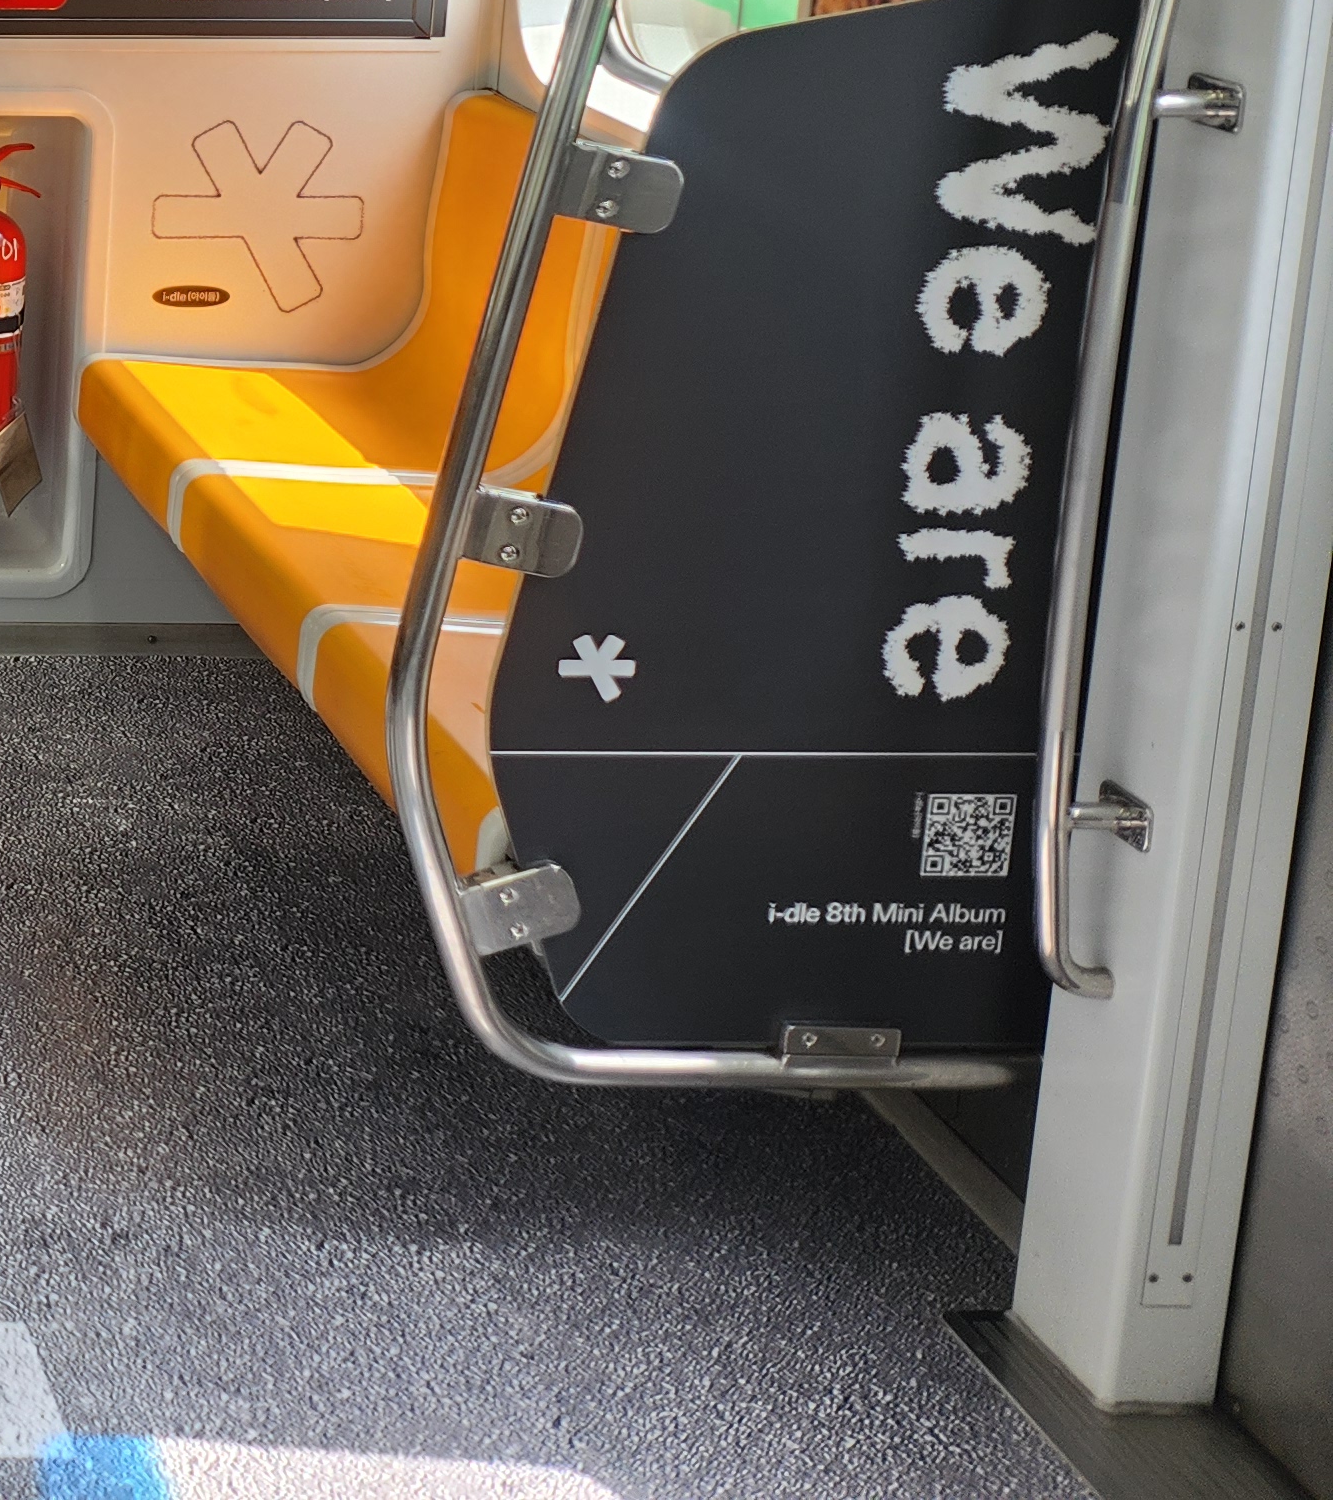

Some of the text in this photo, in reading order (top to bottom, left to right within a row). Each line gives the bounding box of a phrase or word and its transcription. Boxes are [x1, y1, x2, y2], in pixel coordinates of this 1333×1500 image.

[884, 31, 1120, 701] We are
[767, 902, 1006, 924] i-dle 8th Mini Album
[904, 929, 1004, 954] [We are]
